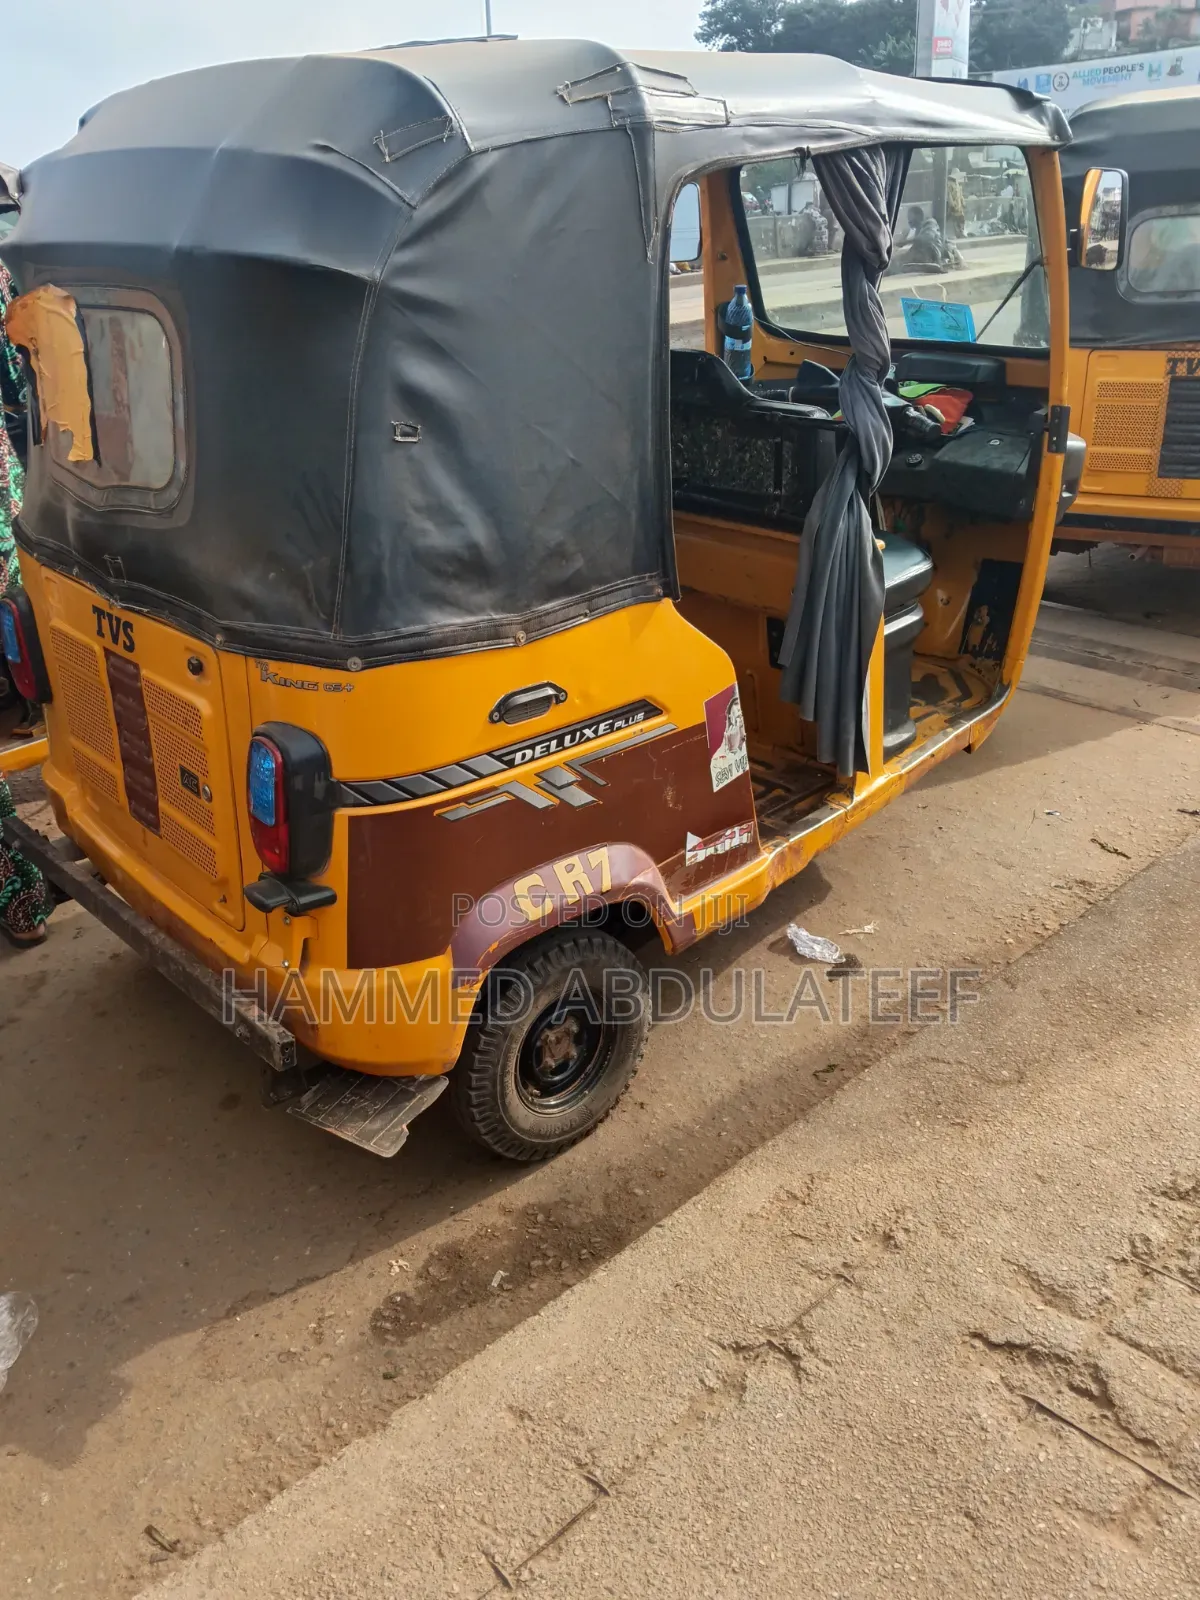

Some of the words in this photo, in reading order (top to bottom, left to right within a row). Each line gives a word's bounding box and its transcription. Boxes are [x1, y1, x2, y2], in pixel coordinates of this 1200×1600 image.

[1072, 67, 1101, 79] ALLIED
[1102, 62, 1145, 76] PEOPLE'S
[1082, 72, 1133, 86] MOVEMENT
[91, 603, 135, 653] TVS
[260, 669, 319, 692] KING
[322, 681, 354, 693] GS+
[514, 719, 613, 766] DELUXE
[612, 711, 645, 732] PLUS
